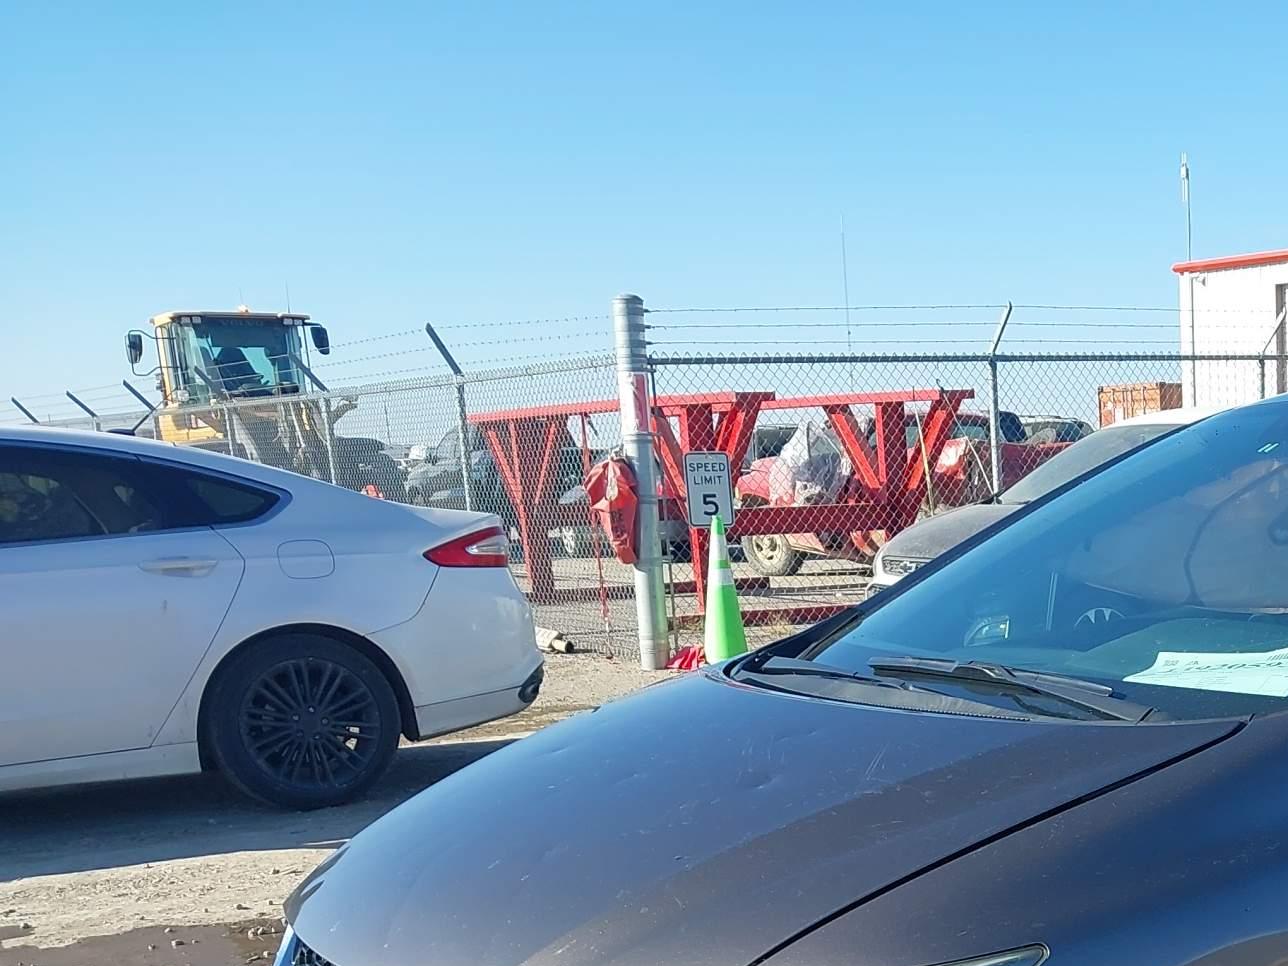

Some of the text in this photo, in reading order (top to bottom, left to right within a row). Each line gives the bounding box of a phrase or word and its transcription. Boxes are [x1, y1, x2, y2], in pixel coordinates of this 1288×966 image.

[219, 319, 265, 327] VOLVO
[688, 462, 727, 473] SPEED
[693, 475, 723, 486] LIMIT
[702, 493, 720, 516] 5
